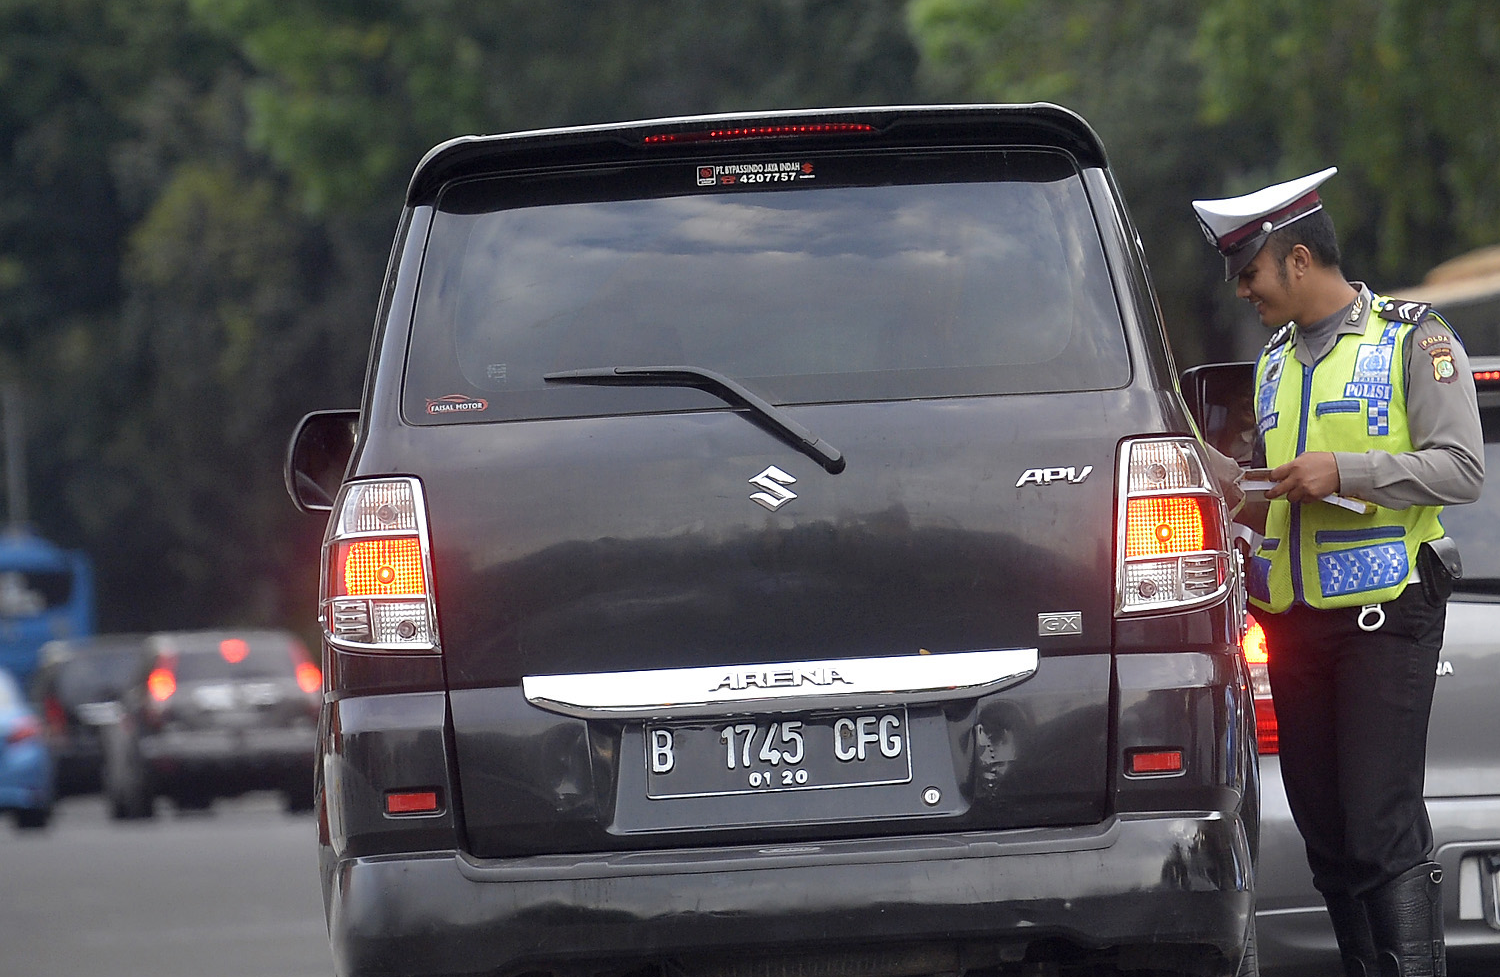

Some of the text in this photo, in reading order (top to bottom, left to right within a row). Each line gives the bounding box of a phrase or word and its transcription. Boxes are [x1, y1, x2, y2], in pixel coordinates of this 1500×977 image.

[764, 163, 779, 173] JAYA
[780, 162, 801, 172] INDAH
[740, 172, 797, 184] 4207757
[1421, 335, 1449, 347] POLDA
[1345, 384, 1390, 400] POLISI
[431, 402, 483, 413] FAISAL MOTOR
[1016, 465, 1094, 487] APV
[1042, 615, 1078, 631] GX
[709, 668, 855, 692] ARENA
[651, 714, 902, 773] B 1745 CFG
[749, 769, 808, 788] 01 20
